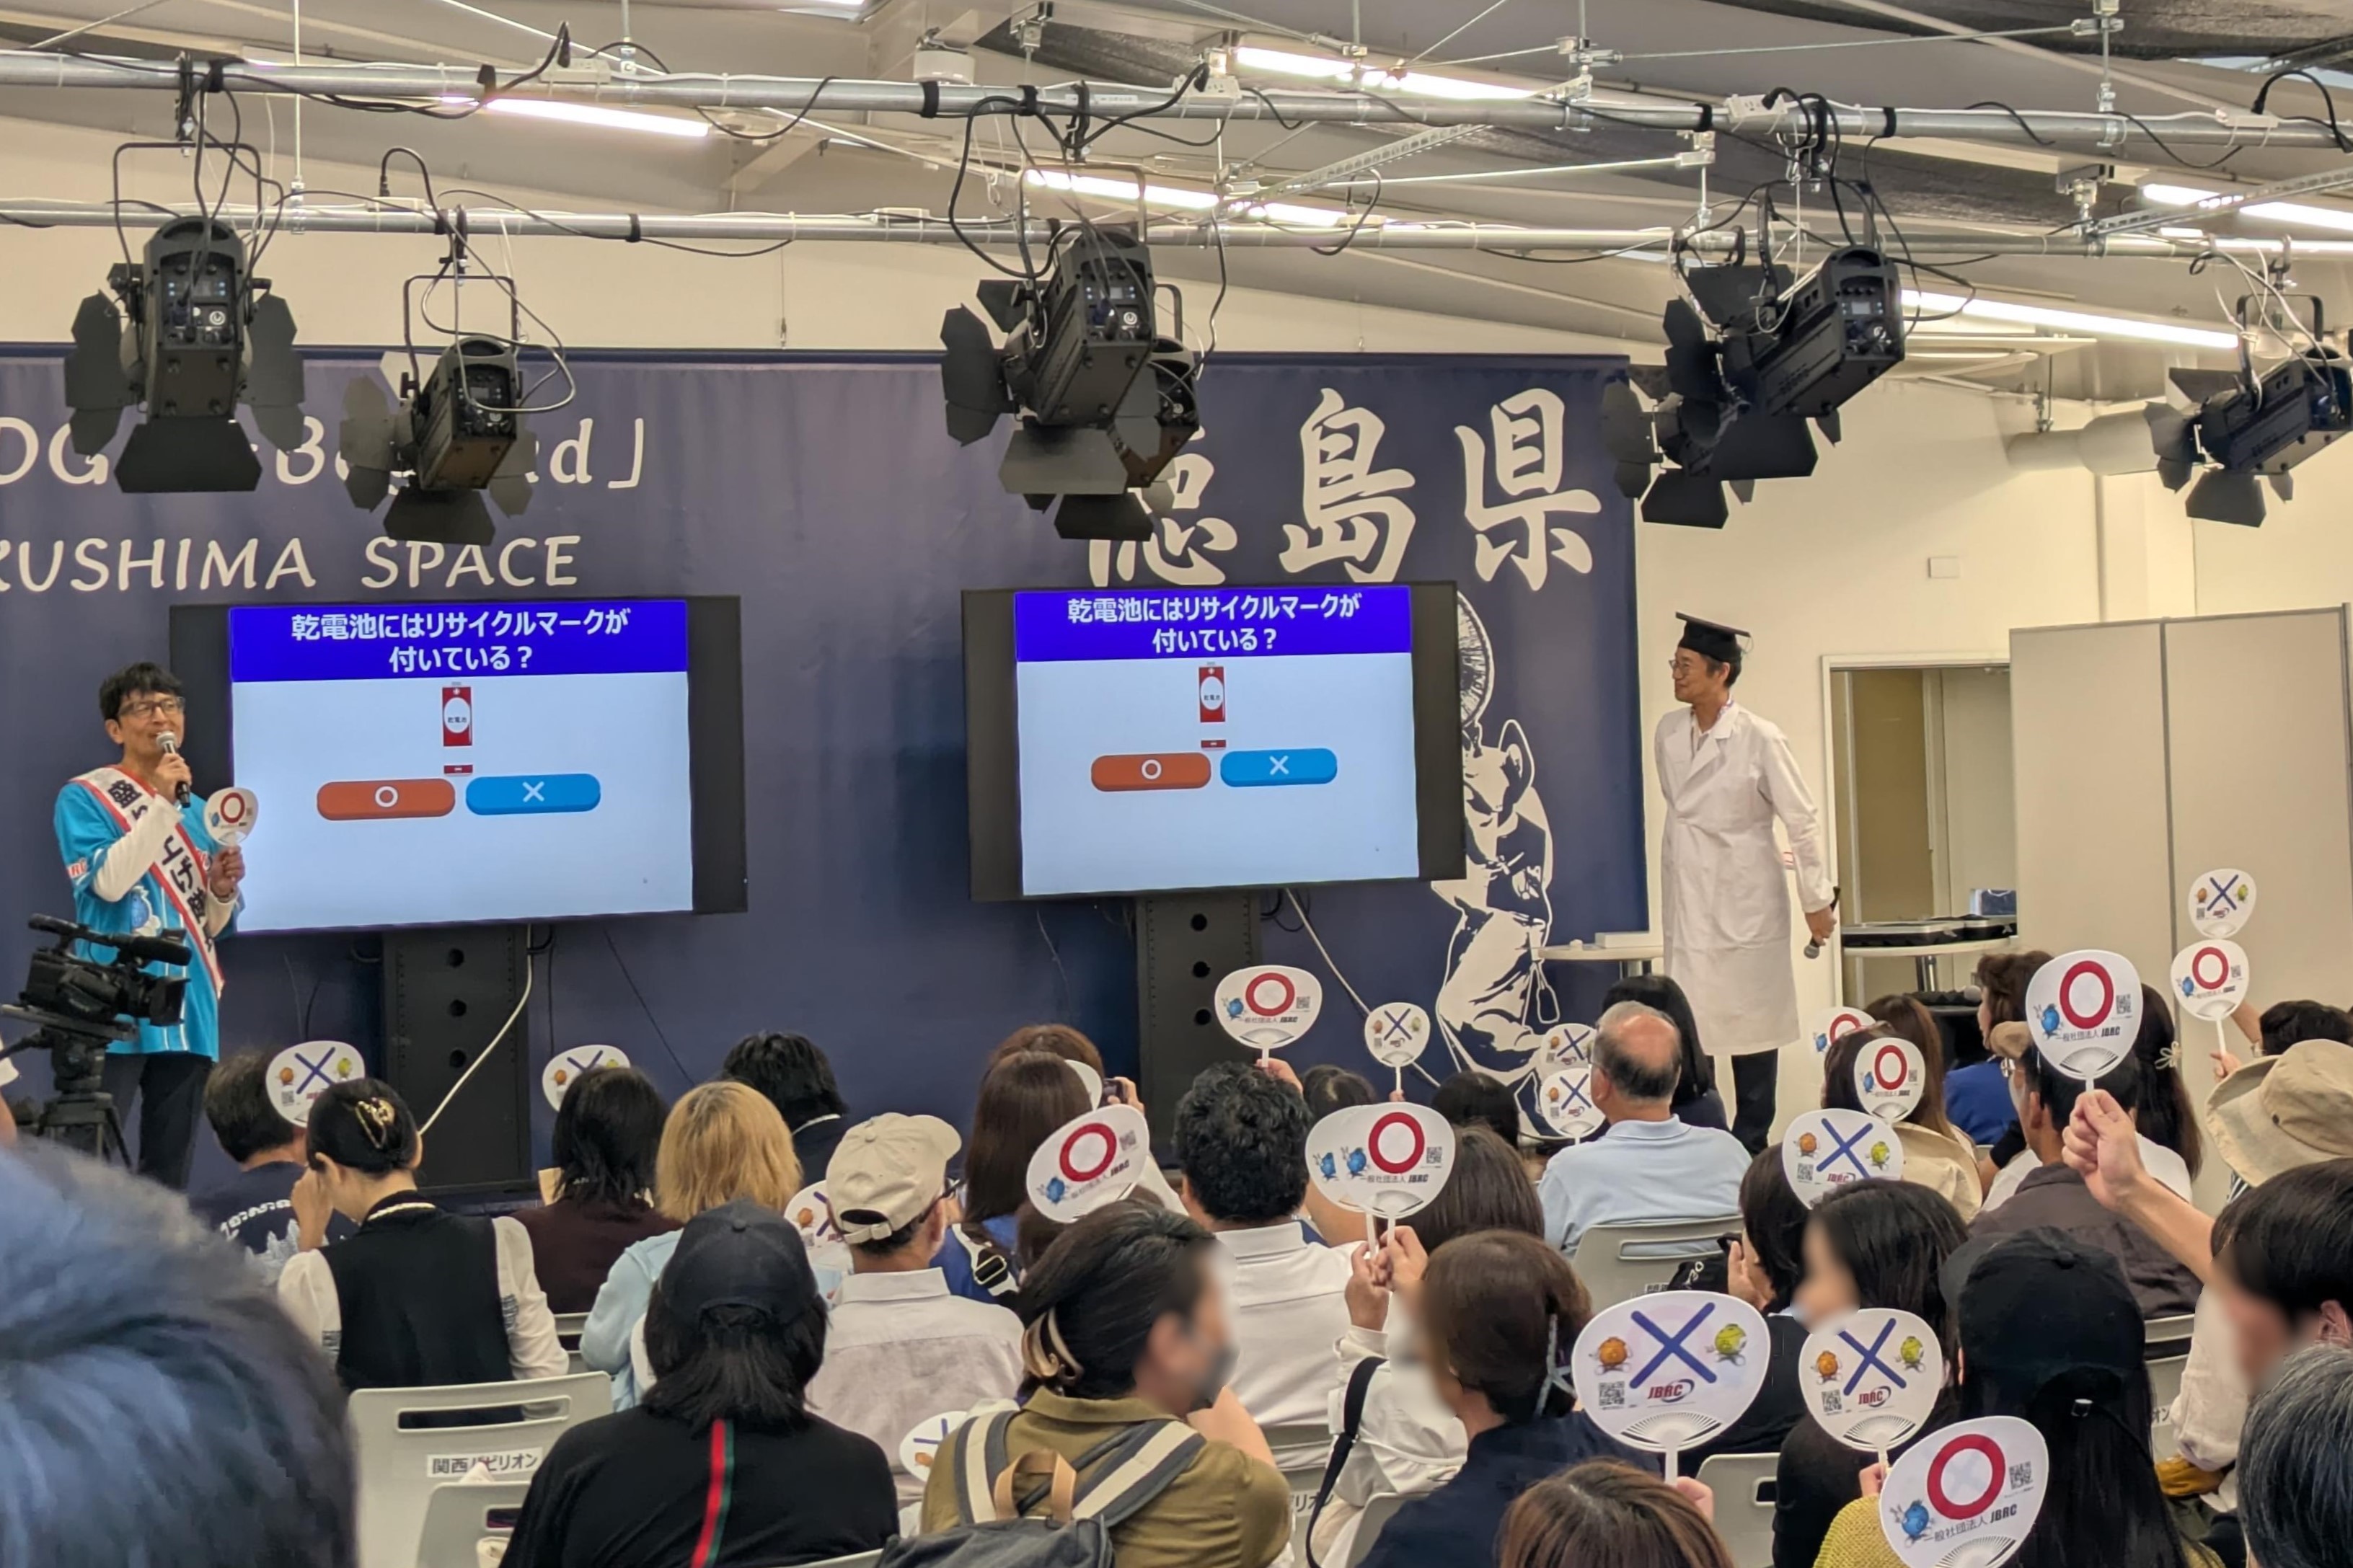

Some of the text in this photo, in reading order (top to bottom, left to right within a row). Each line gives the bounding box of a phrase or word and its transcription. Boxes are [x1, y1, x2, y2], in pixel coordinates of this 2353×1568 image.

[361, 536, 580, 588] SPACE
[1067, 593, 1362, 623] 乾電池にはリサイクルマークが
[291, 608, 631, 641] 乾電池にはリサイクルマークが
[1152, 628, 1277, 653] 付いている？
[389, 646, 533, 673] 付いている？
[1647, 1383, 1685, 1400] JBRC
[1990, 1504, 2018, 1524] JBRC
